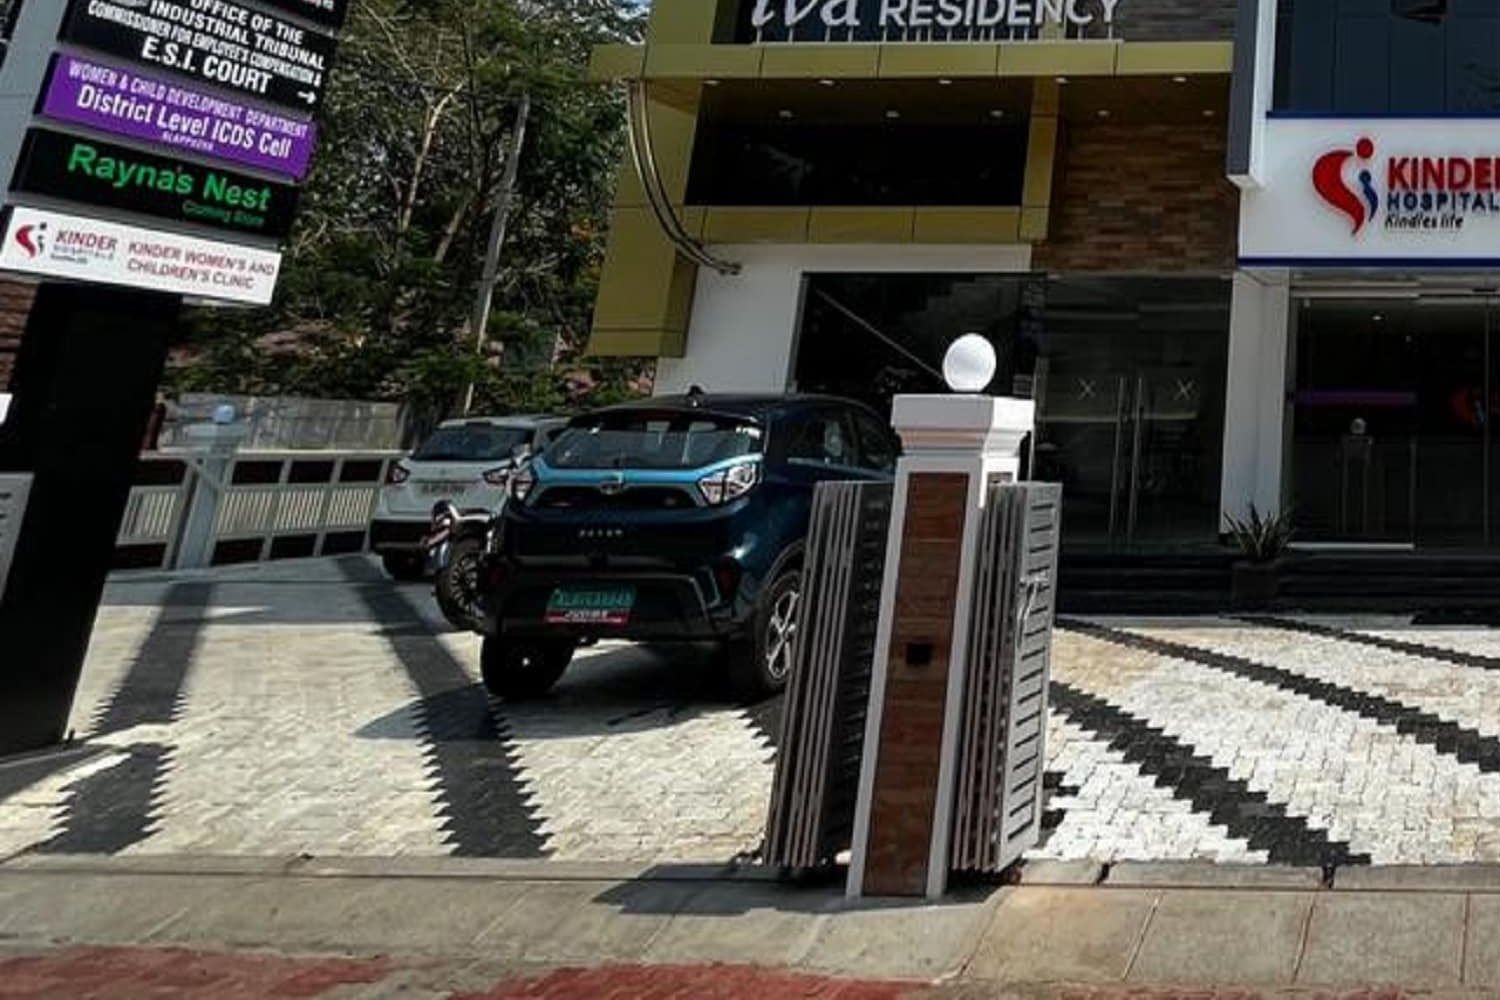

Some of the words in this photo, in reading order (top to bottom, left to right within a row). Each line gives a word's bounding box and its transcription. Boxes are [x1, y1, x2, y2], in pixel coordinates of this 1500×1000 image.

[251, 14, 272, 32] OF
[276, 22, 304, 45] THE
[142, 36, 196, 71] E.S.I.
[203, 55, 272, 94] COURT
[255, 33, 325, 70] TRIBUNAL
[69, 61, 117, 88] WOMEN
[118, 74, 128, 90] &
[130, 74, 167, 101] CHILD
[168, 87, 243, 120] DEVELOPMENT
[245, 109, 308, 138] DEPARTMENT
[76, 85, 152, 130] District
[156, 106, 209, 135] Level
[211, 119, 254, 149] ICDS
[259, 132, 293, 159] Cell
[202, 173, 272, 211] Nest
[1441, 214, 1464, 229] life
[55, 229, 118, 251] KINDER
[127, 241, 182, 260] KINDER
[184, 251, 247, 272] WOMEN'S
[248, 262, 275, 276] AND
[127, 258, 209, 283] CHILDREN'S
[212, 271, 256, 289] CLINIC
